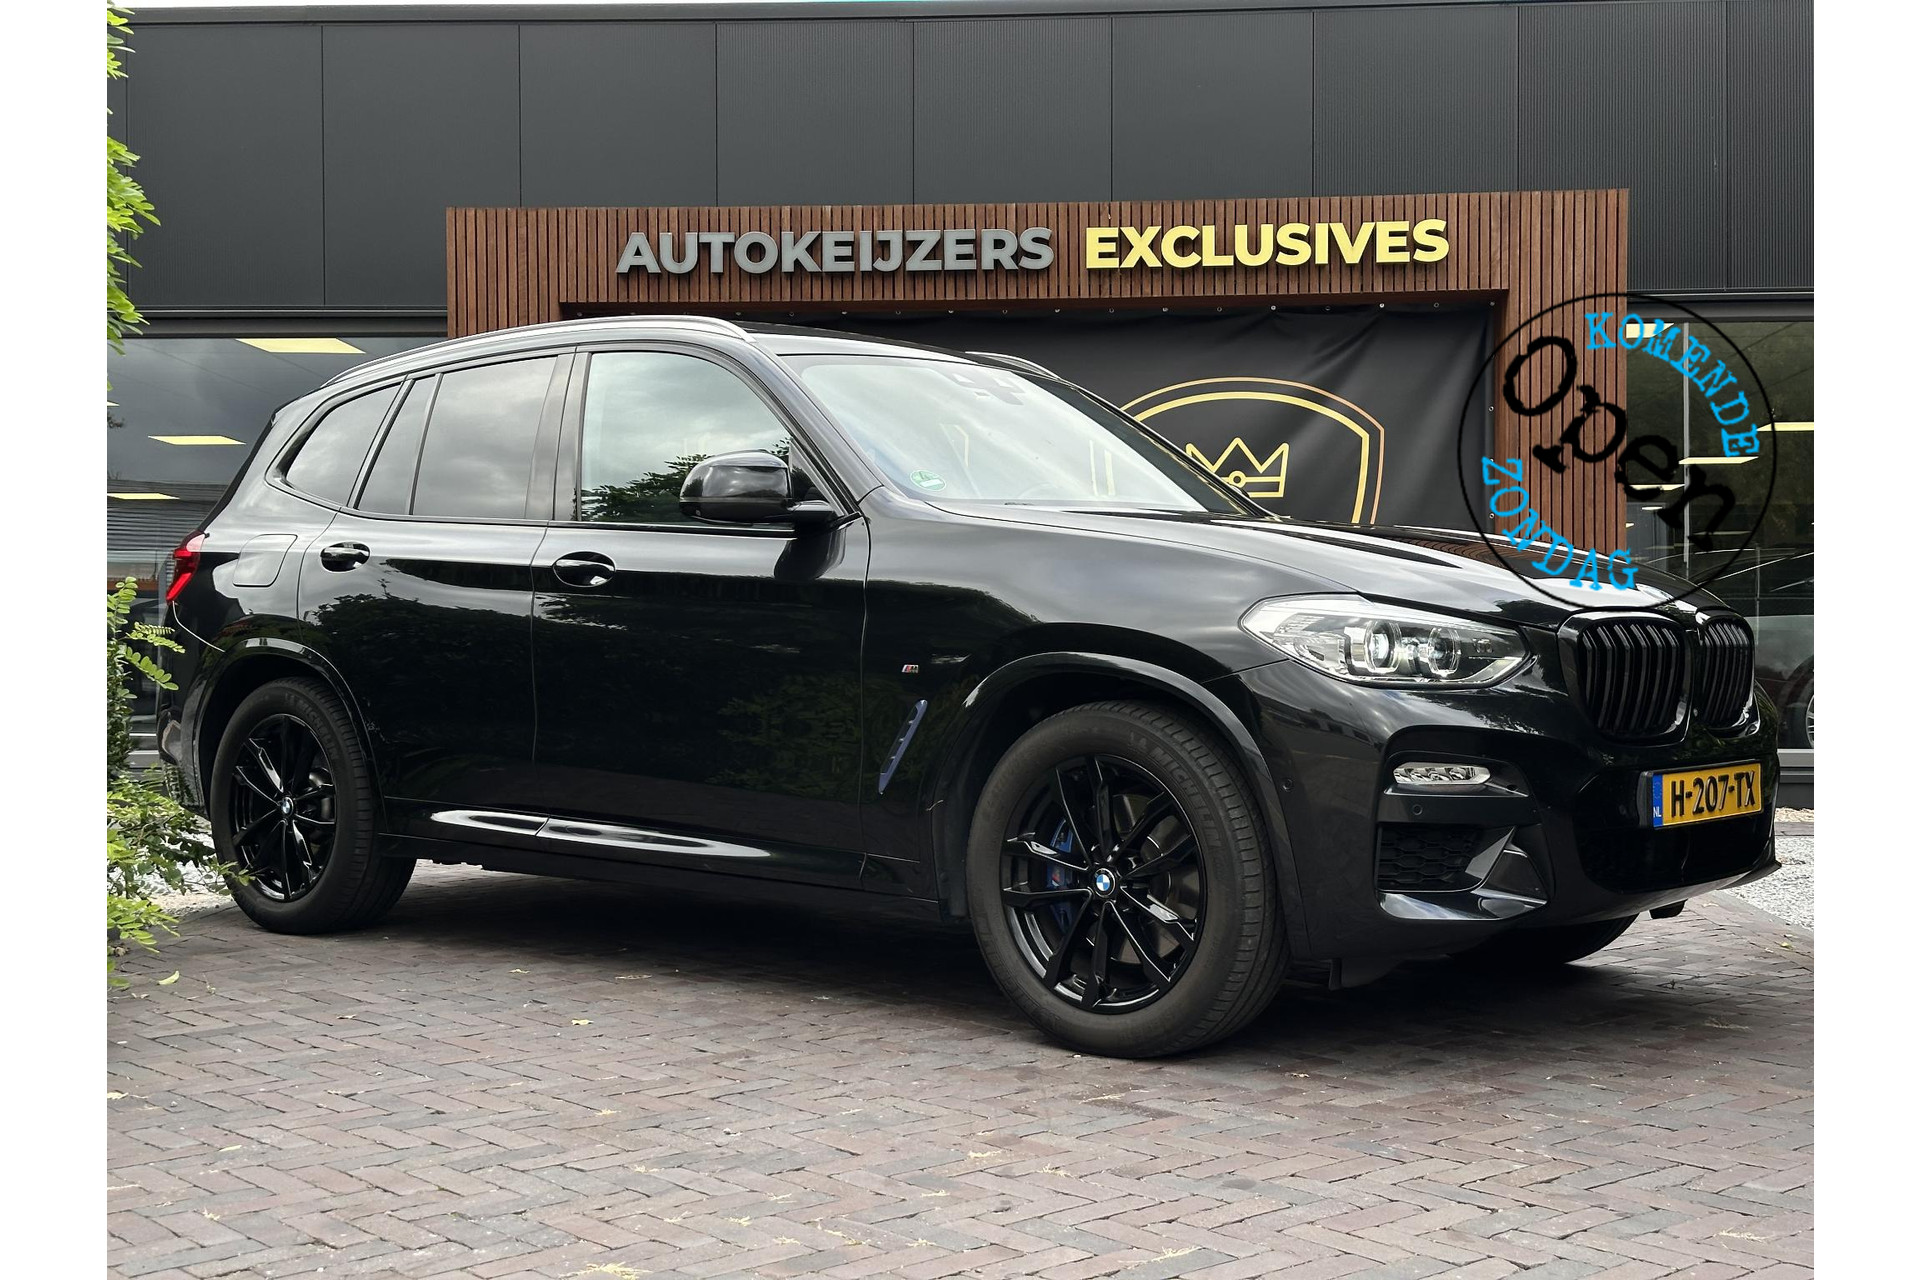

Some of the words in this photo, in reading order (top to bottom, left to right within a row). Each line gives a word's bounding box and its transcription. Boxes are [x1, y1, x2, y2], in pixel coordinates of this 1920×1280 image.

[616, 227, 1054, 275] AUTOKEIJZERS
[1086, 218, 1450, 269] EXCLUSIVES
[1652, 805, 1662, 818] NL
[1671, 770, 1756, 819] H-207-TX
